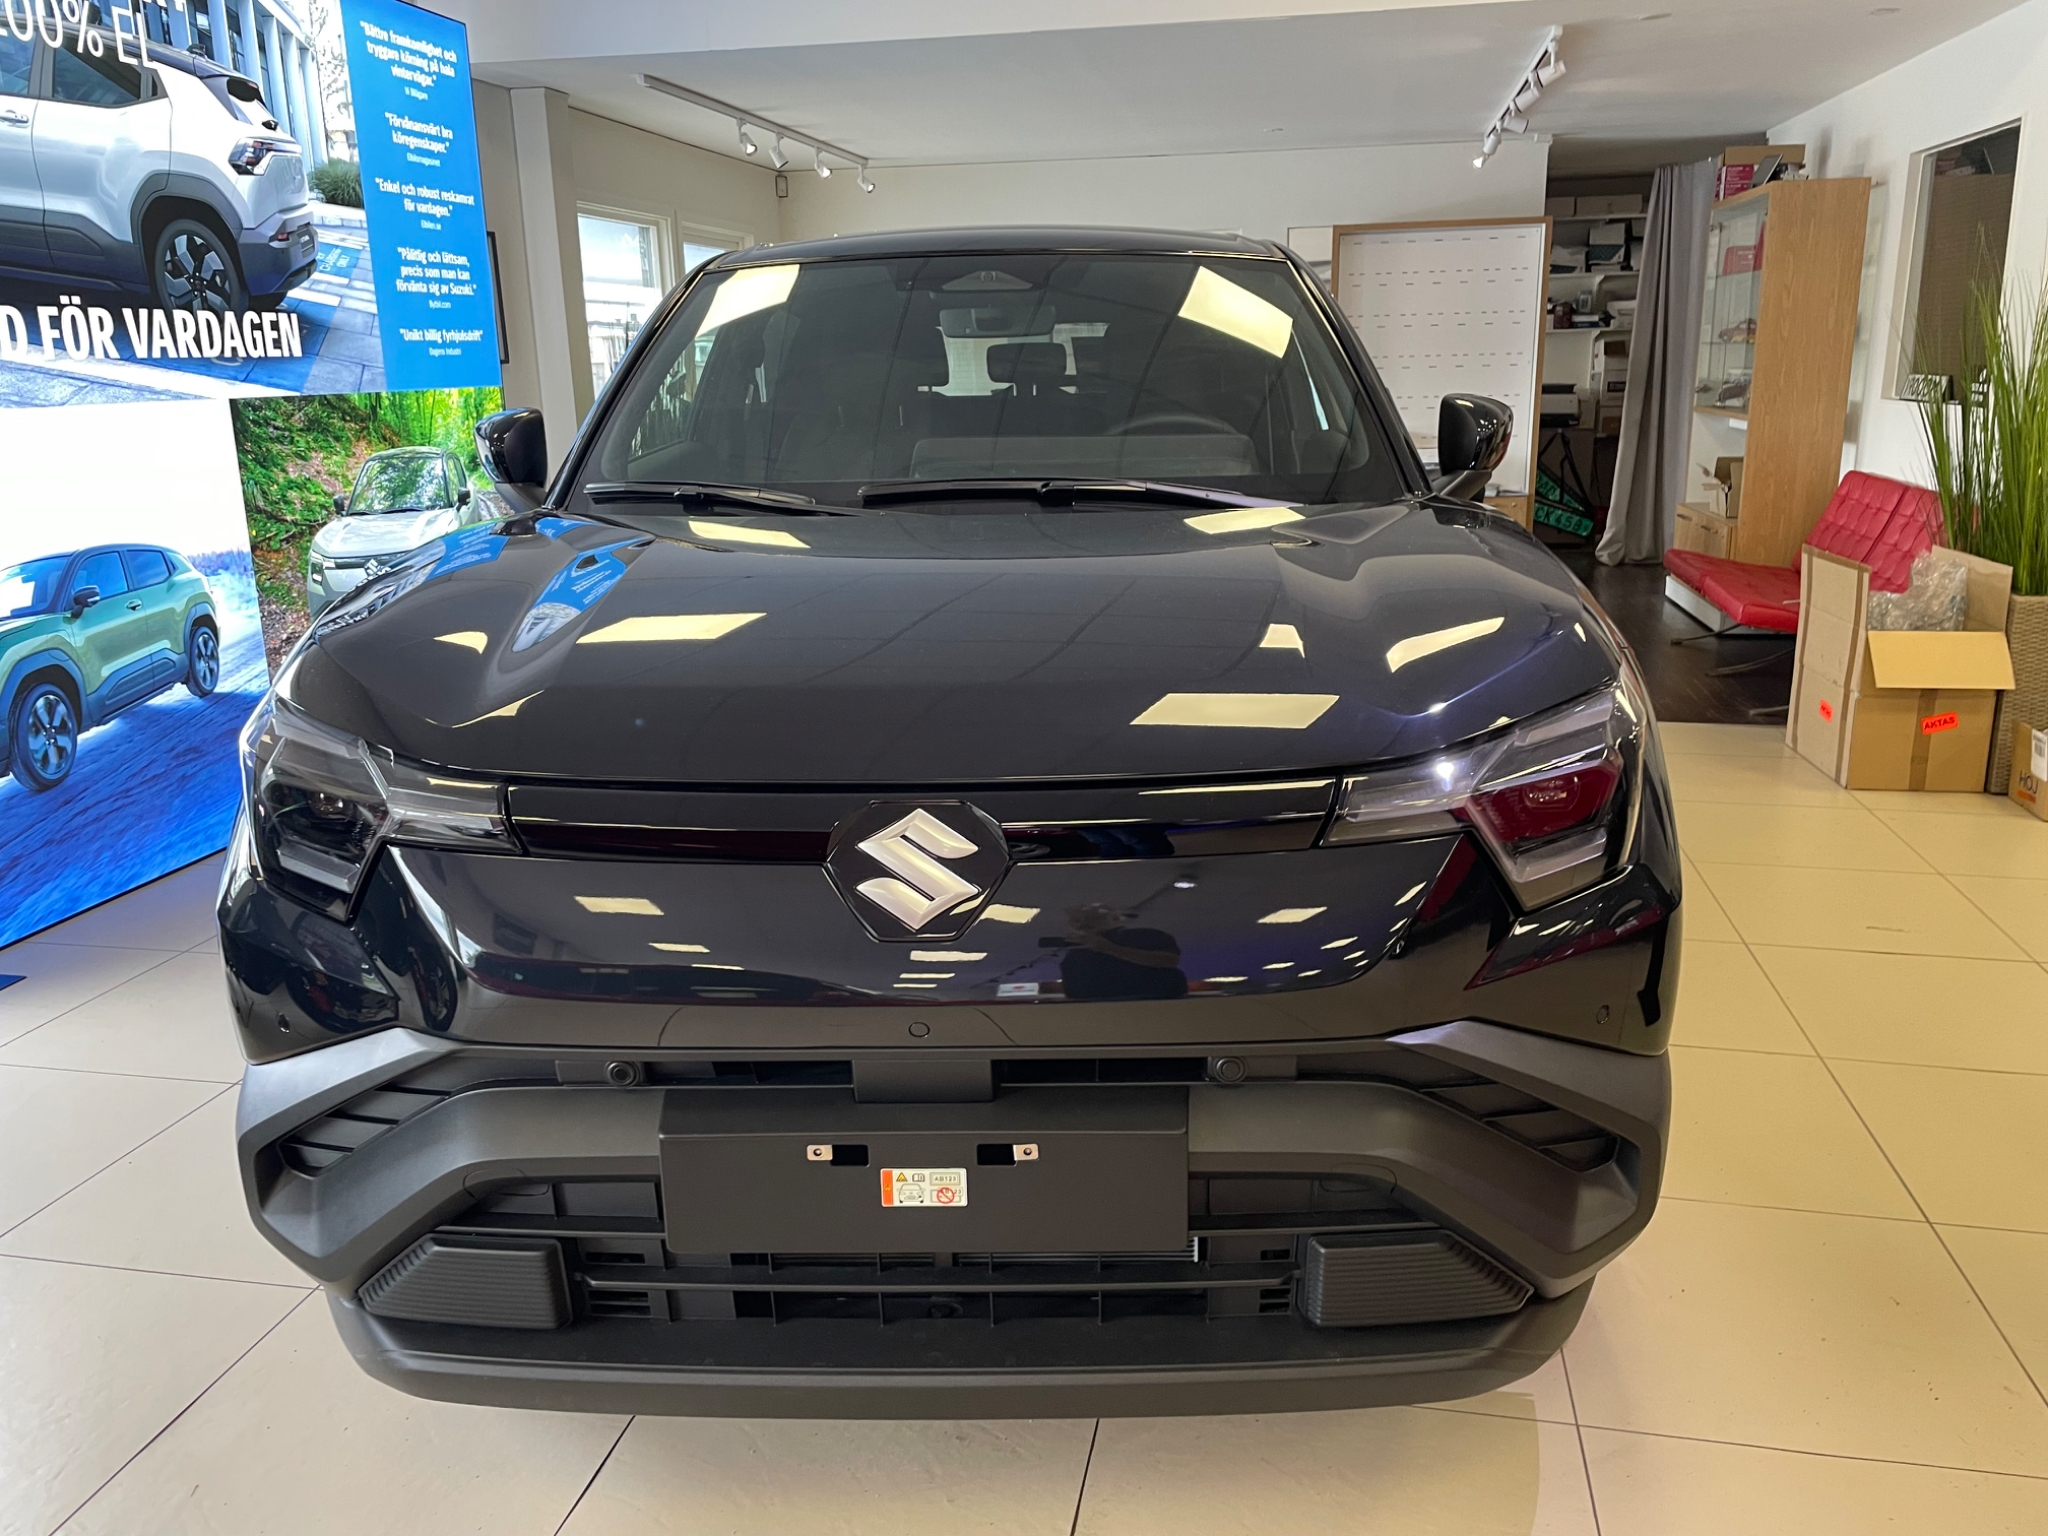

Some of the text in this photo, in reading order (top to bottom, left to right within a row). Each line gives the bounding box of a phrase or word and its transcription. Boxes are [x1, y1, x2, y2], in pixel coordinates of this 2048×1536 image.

[0, 0, 158, 69] 00% EL
[366, 41, 455, 78] tryggare körning på hala
[443, 49, 457, 63] och
[441, 125, 453, 140] bra
[402, 184, 416, 196] och
[417, 185, 441, 200] robust
[441, 189, 475, 206] reskamrat
[404, 198, 416, 211] för
[428, 251, 441, 264] och
[400, 264, 470, 281] precis som man kan
[396, 281, 427, 294] förvänta
[428, 282, 440, 297] sig
[440, 285, 450, 294] av
[36, 294, 121, 361] FÖR
[122, 307, 303, 359] VARDAGEN
[424, 329, 442, 344] billig
